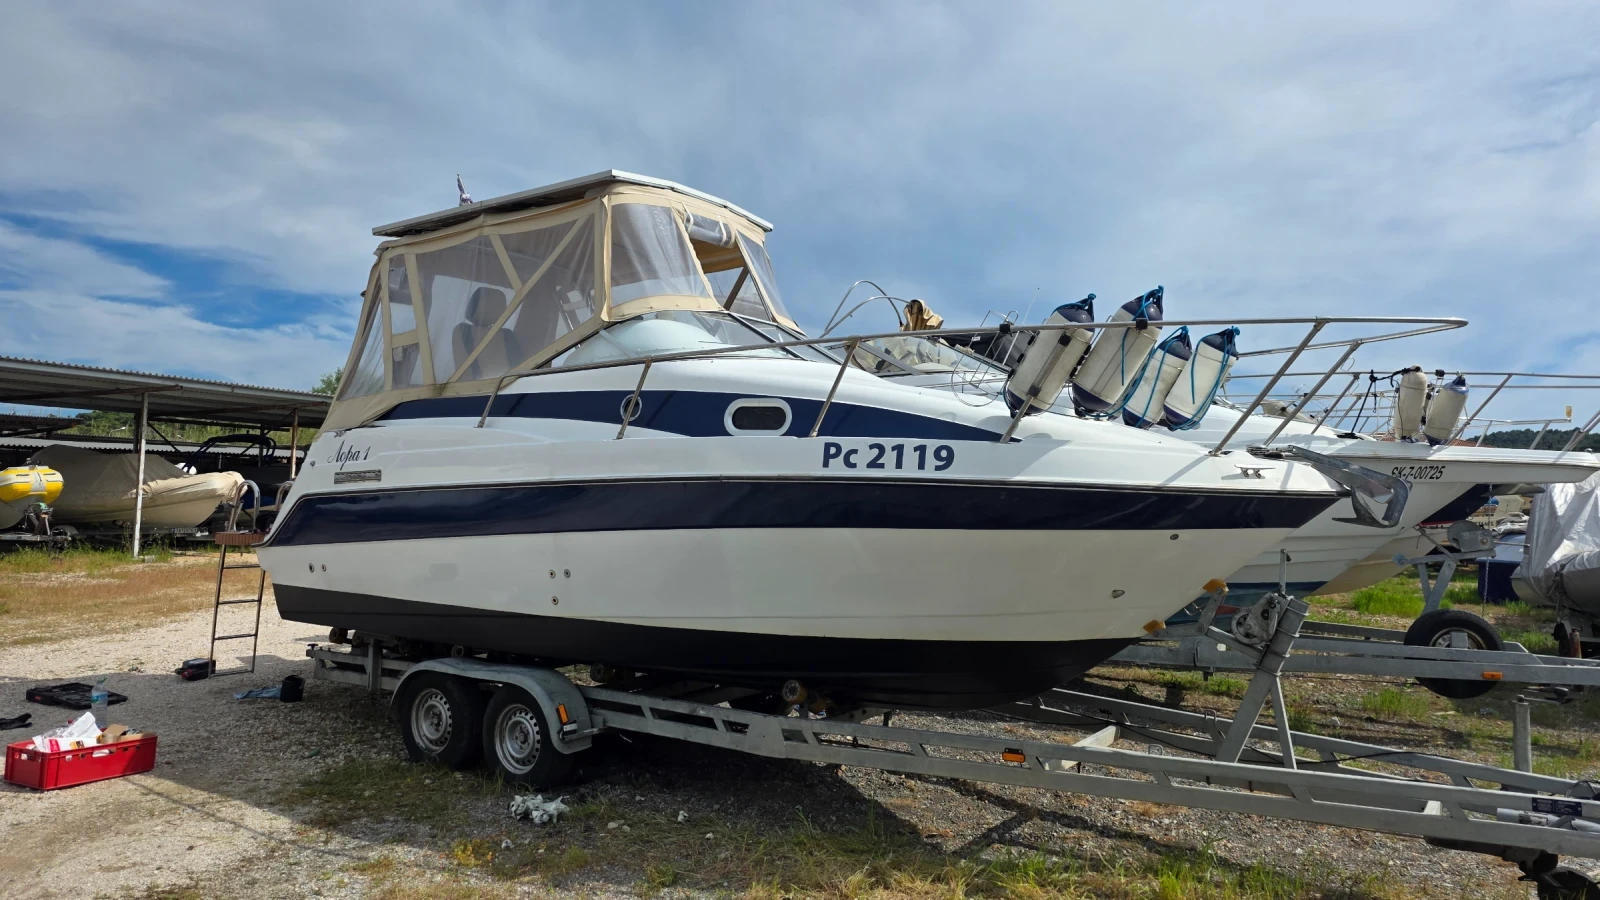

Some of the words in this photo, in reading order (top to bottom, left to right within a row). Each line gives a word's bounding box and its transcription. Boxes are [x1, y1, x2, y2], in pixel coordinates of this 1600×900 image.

[363, 445, 371, 460] 1
[866, 443, 955, 471] 2119
[1391, 466, 1446, 480] SK-7-00725
